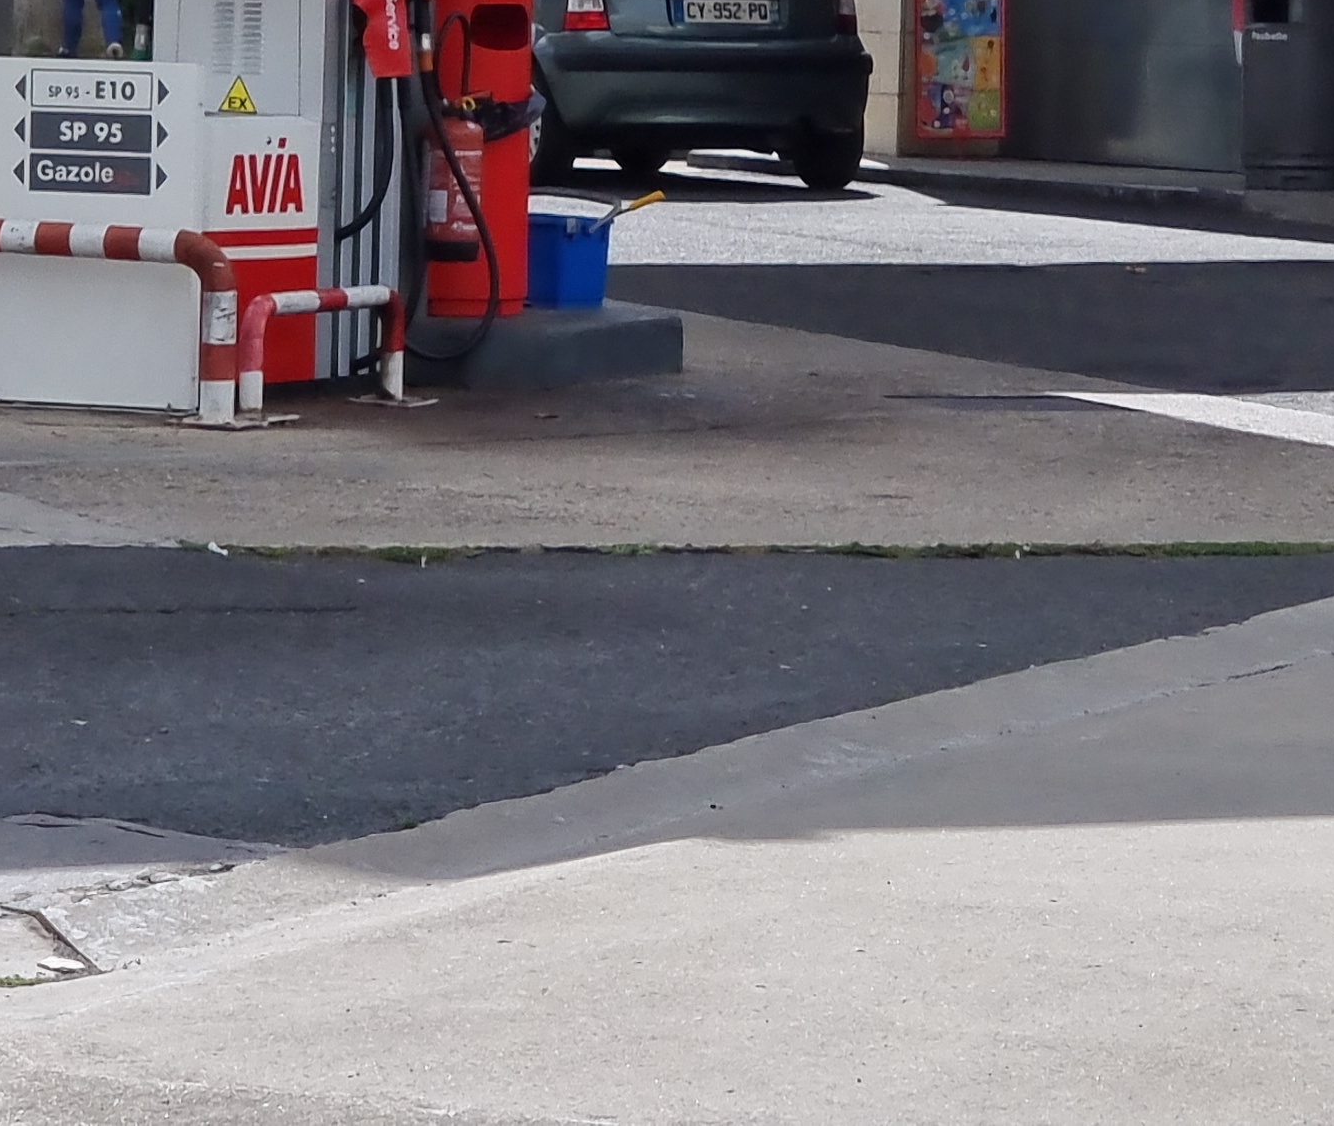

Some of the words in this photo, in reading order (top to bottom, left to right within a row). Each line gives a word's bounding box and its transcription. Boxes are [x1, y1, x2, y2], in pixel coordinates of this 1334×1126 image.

[48, 84, 62, 97] SP
[65, 85, 80, 98] 95
[95, 80, 136, 101] E10
[228, 96, 248, 111] EX
[59, 120, 87, 142] SP
[94, 122, 123, 144] 95
[36, 159, 115, 184] Gazole
